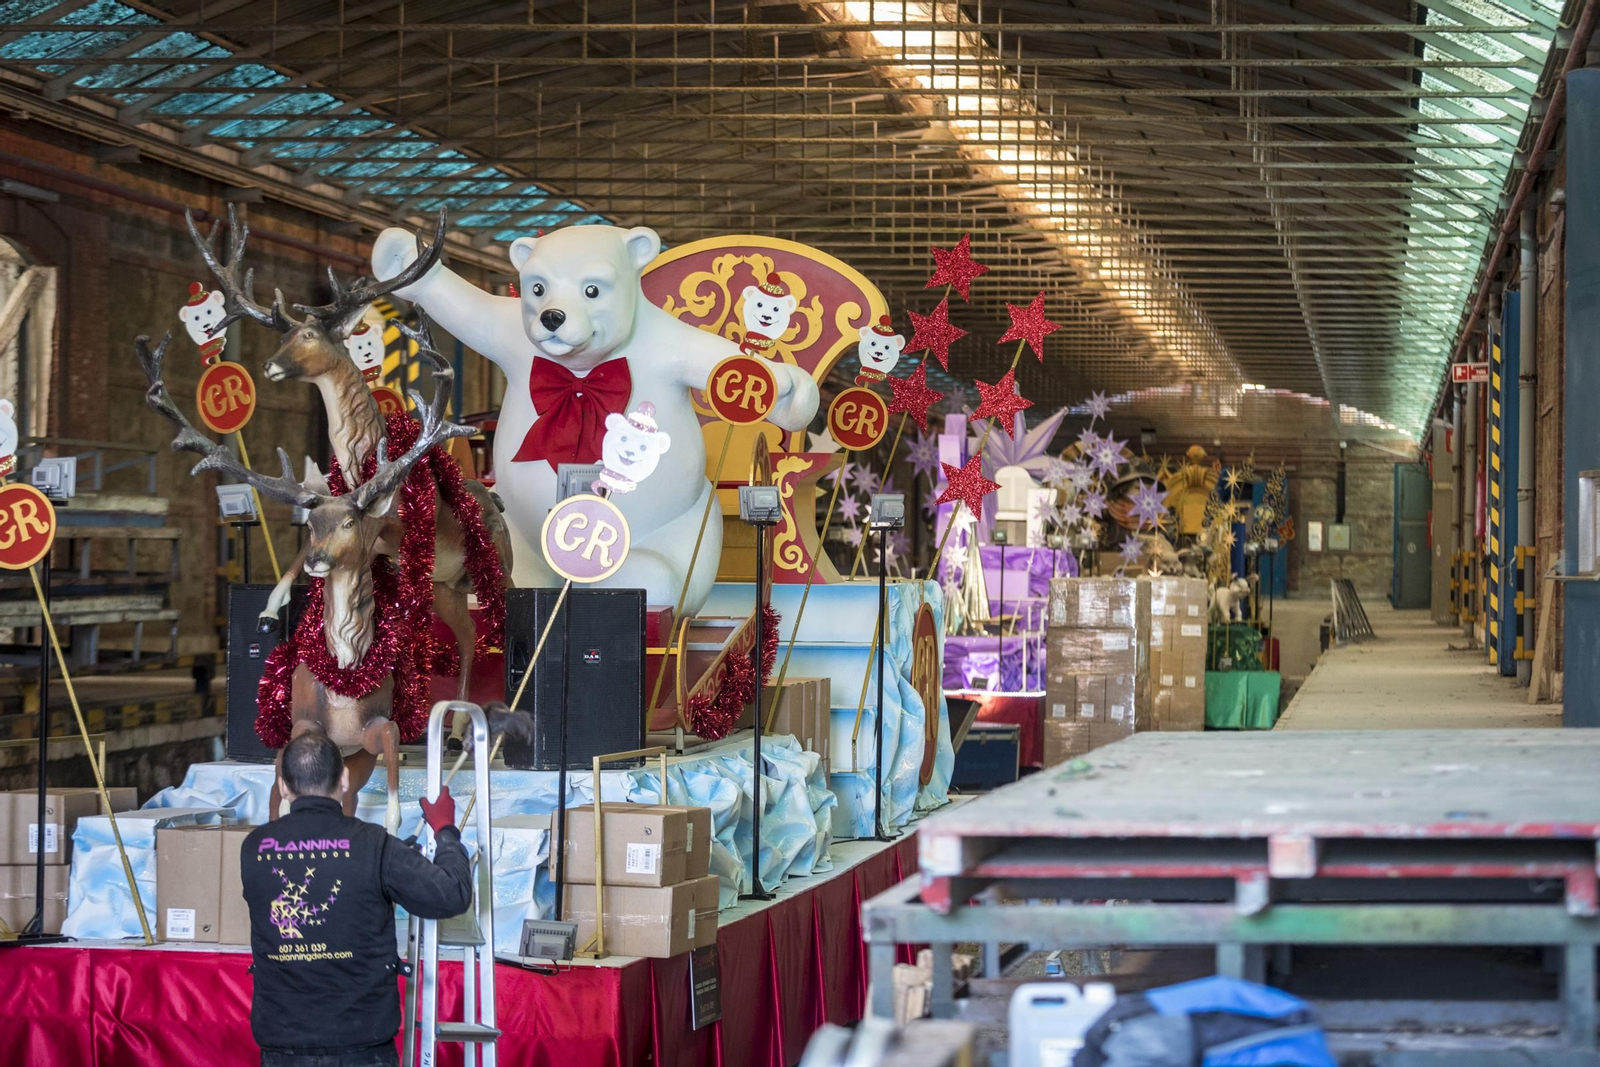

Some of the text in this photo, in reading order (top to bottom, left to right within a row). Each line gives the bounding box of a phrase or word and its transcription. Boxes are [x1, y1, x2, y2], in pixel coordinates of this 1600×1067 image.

[258, 837, 350, 853] PLANNING
[278, 943, 327, 953] 607 361 039
